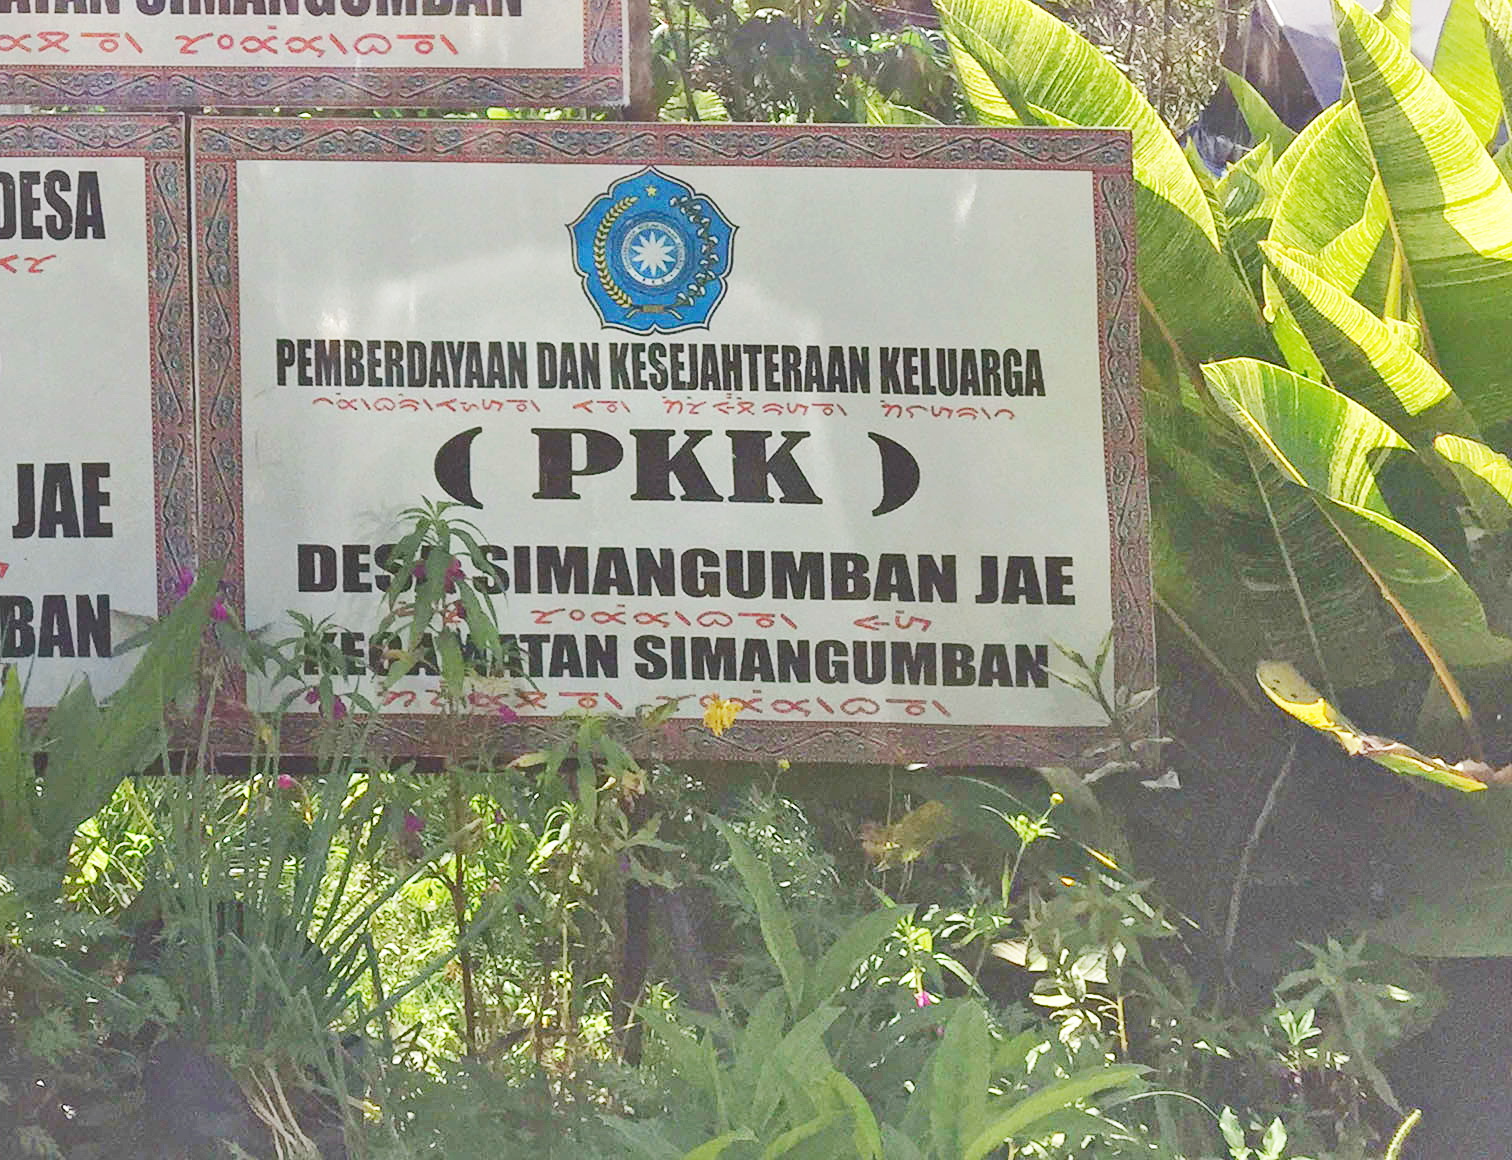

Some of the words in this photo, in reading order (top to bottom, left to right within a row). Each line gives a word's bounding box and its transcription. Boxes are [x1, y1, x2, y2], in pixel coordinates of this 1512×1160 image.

[275, 338, 529, 389] PEMBERDAYAAN
[536, 341, 600, 390] DAN
[608, 342, 871, 394] KESEJAHTERAAN
[879, 346, 1047, 398] KELUARGA
[531, 427, 824, 504] PKK
[11, 462, 115, 540] JAE
[297, 543, 456, 593] DES
[471, 545, 957, 607] SIMANGUMBAN
[974, 555, 1076, 606] JAE
[633, 634, 1050, 689] SIMANGUMBAN
